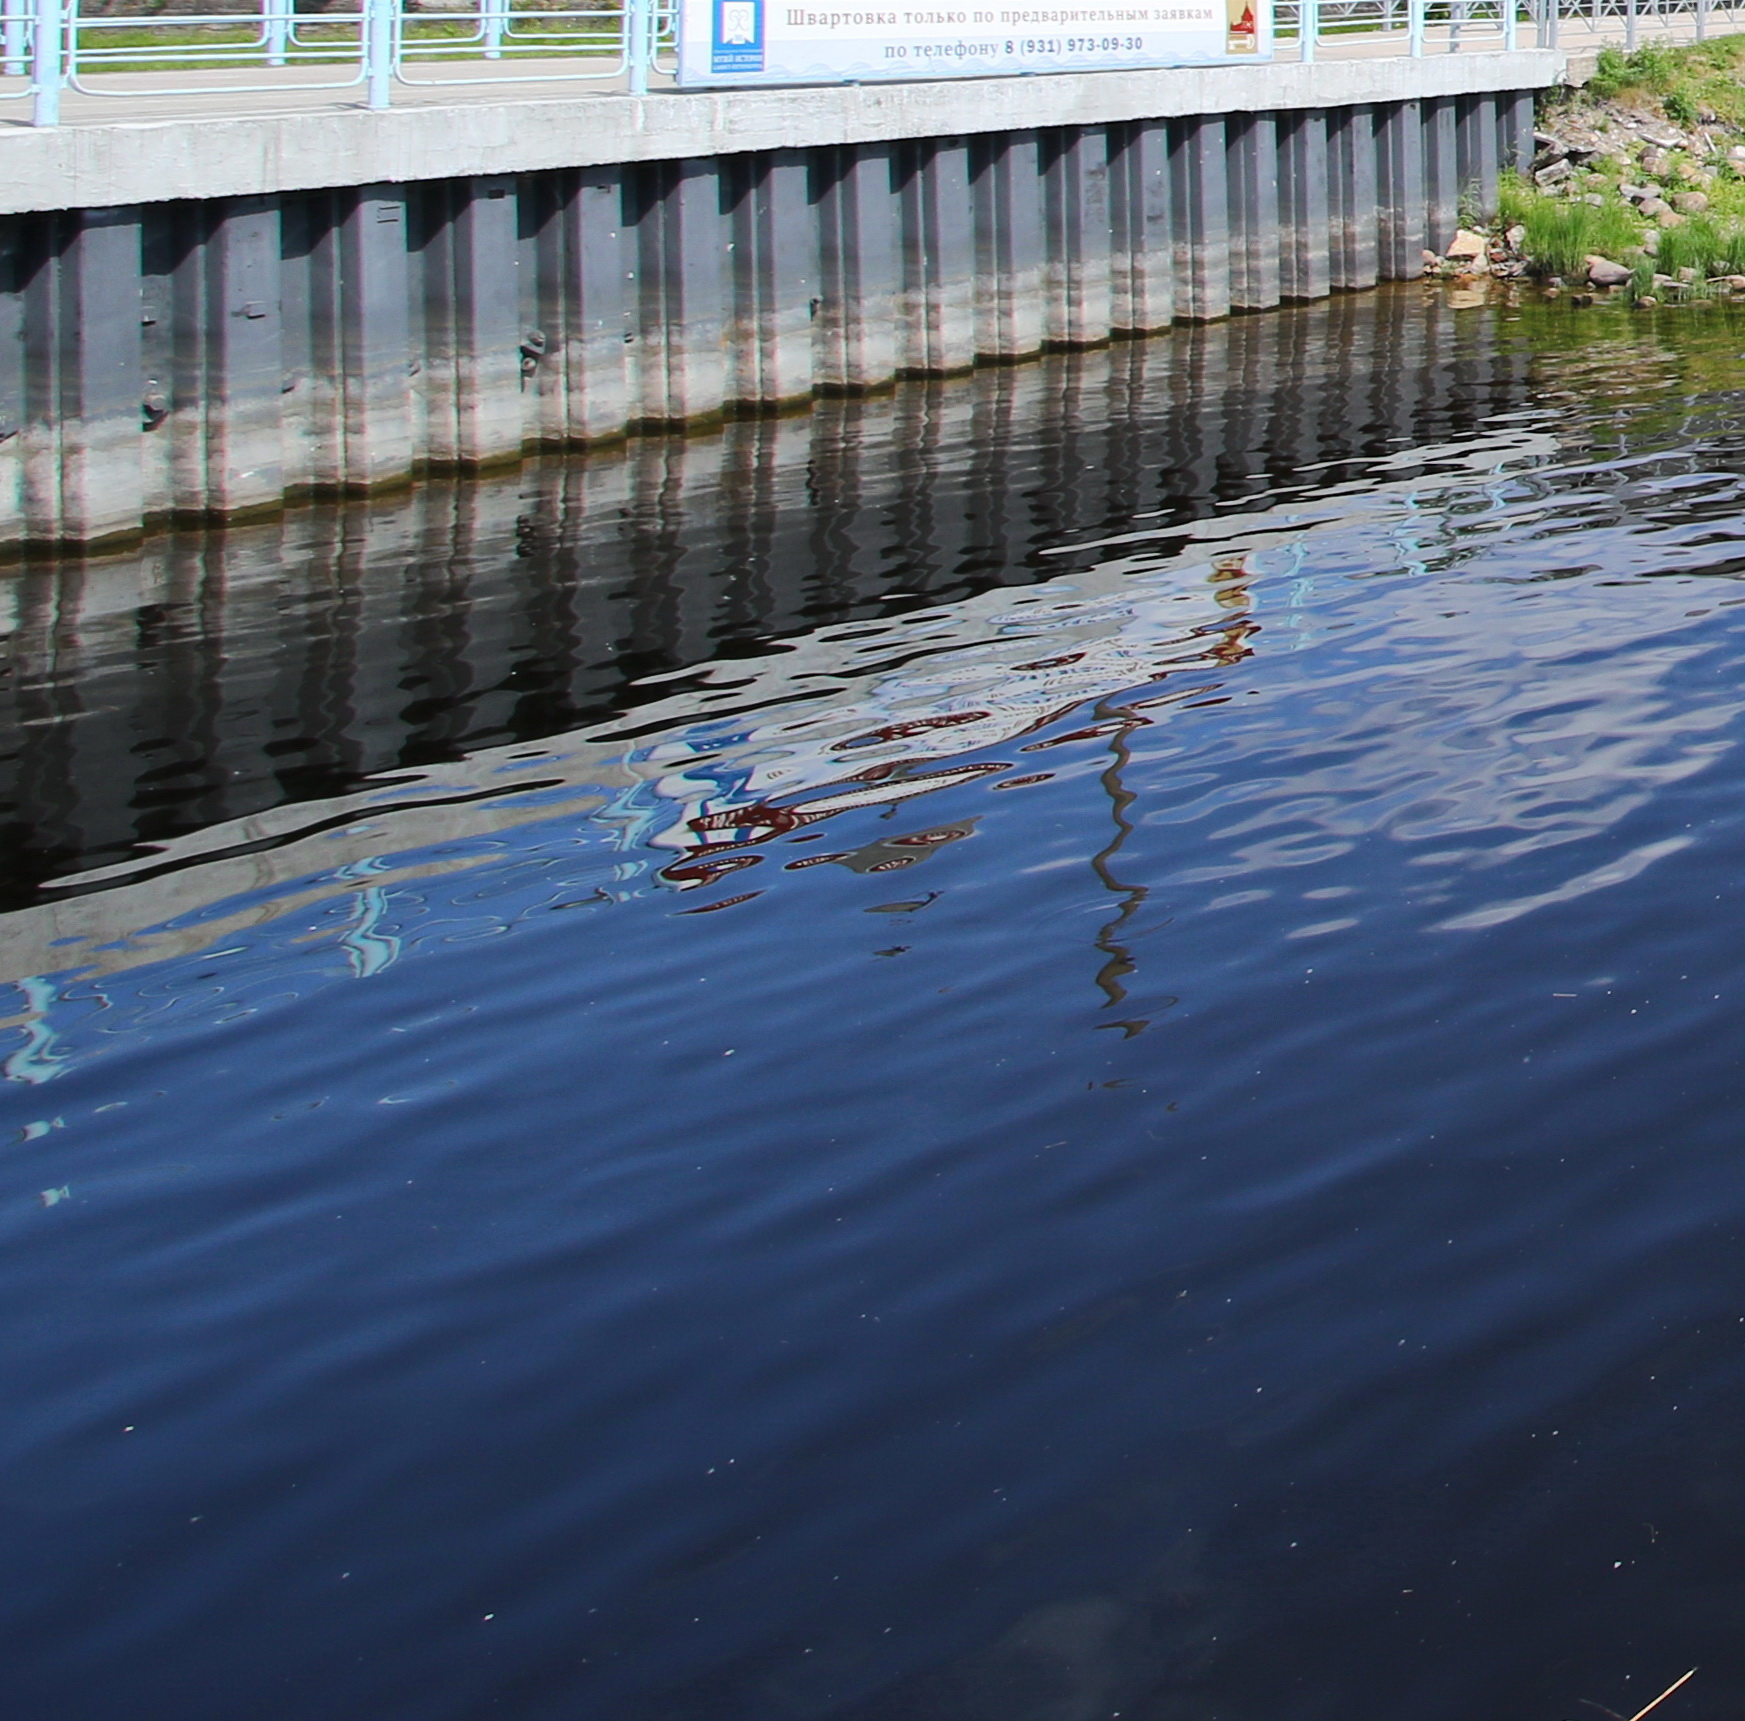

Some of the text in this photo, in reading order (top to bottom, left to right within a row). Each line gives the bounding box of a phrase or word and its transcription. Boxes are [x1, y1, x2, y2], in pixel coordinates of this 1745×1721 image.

[786, 7, 1213, 29] Швартовка только по предварительным заявкам
[884, 36, 1143, 62] по телефону 8 (931) 973-09-30
